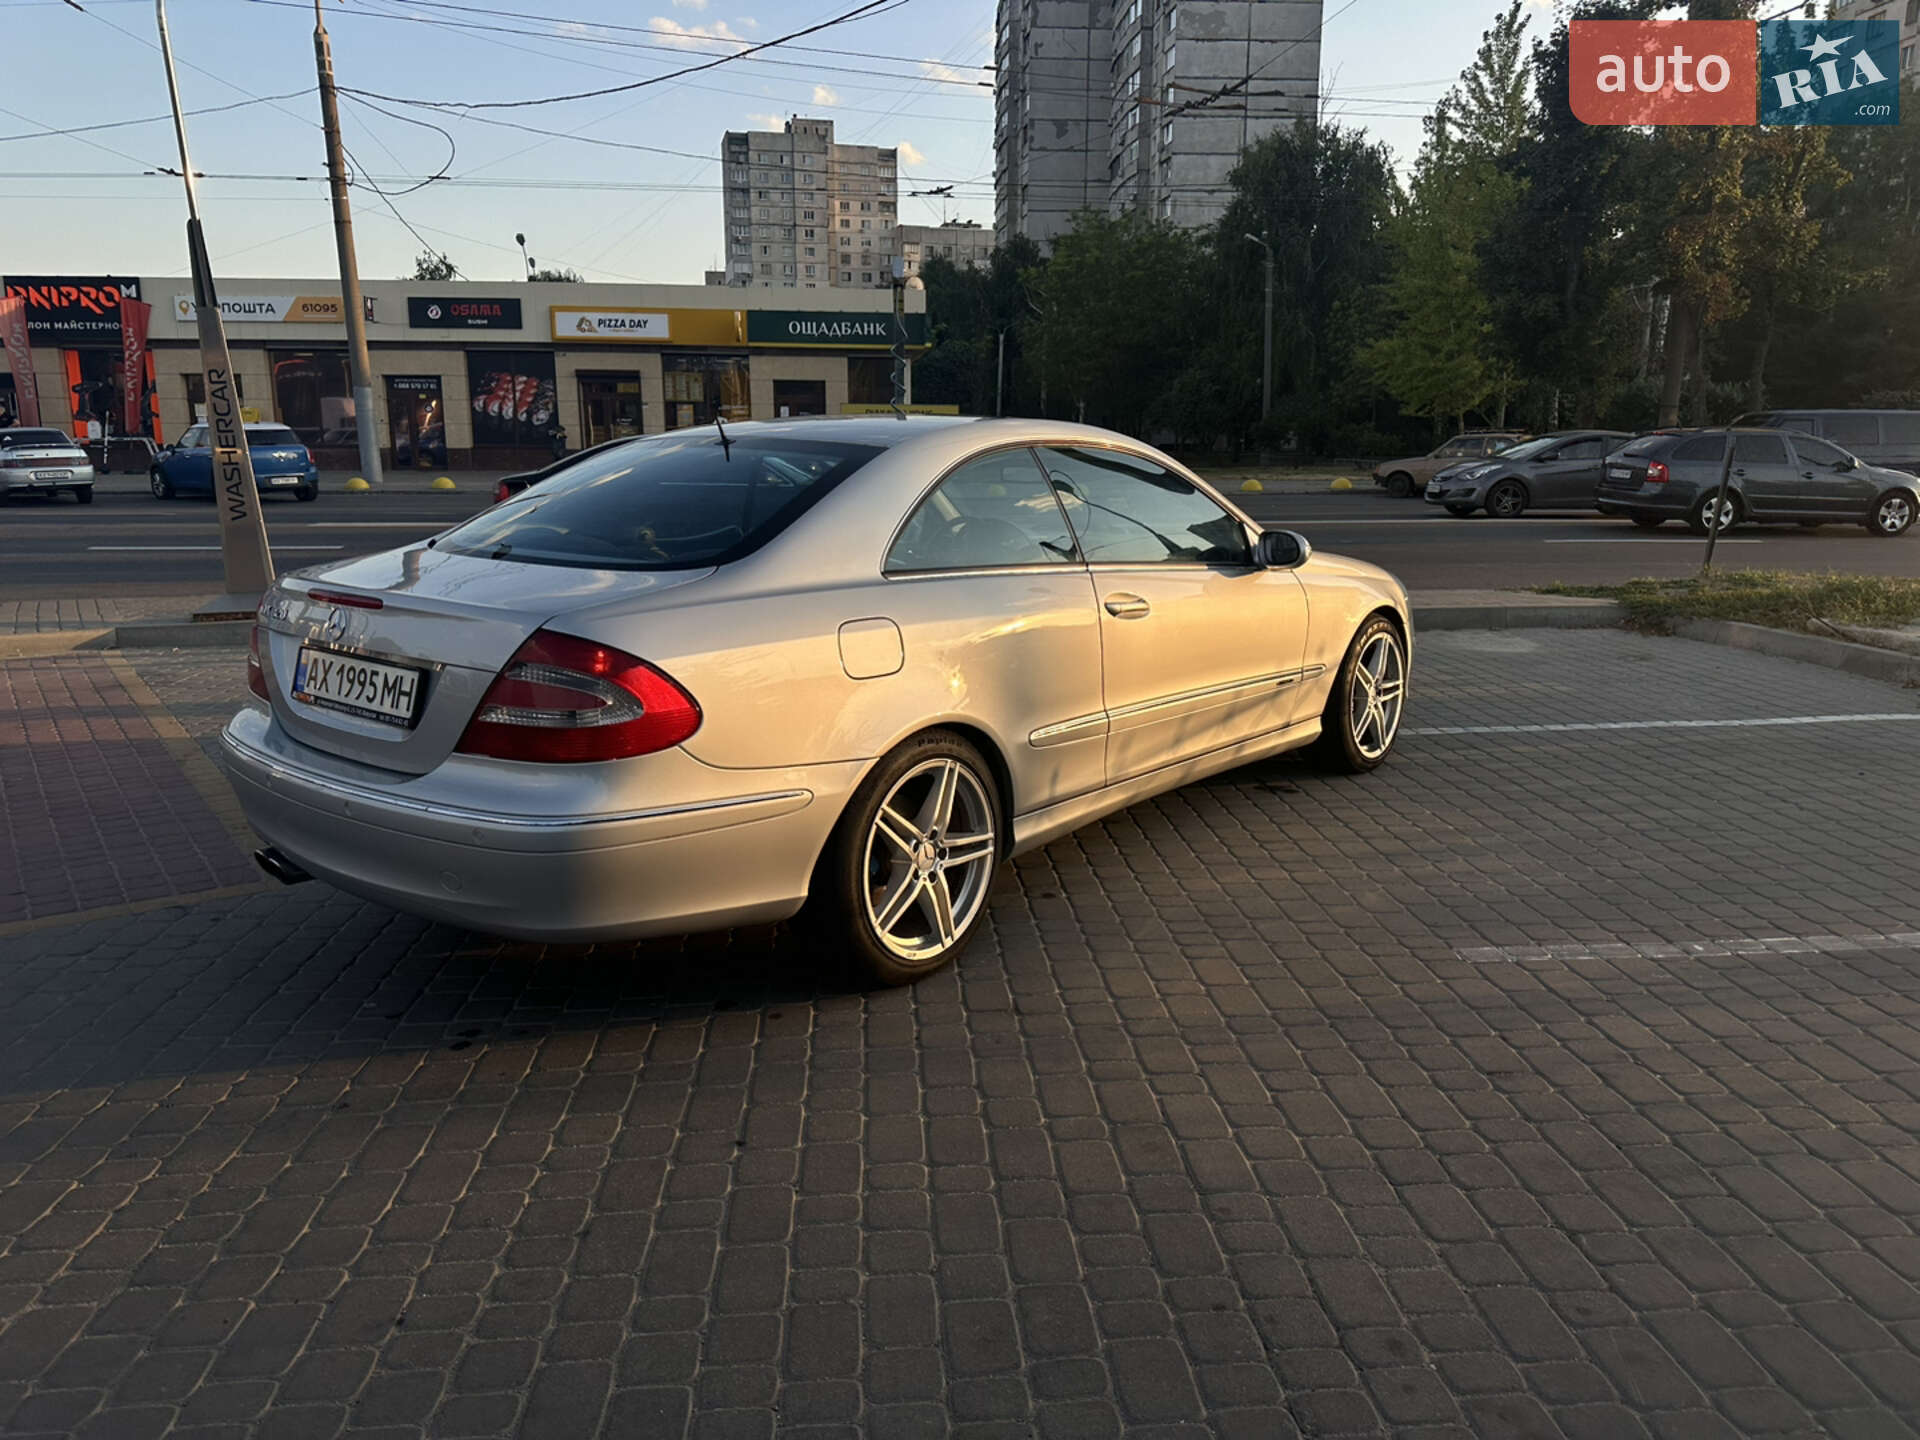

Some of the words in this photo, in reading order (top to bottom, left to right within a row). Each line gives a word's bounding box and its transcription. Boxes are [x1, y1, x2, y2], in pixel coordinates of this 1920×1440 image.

[191, 302, 276, 314] ПОШТА
[302, 303, 338, 313] 61095
[451, 304, 502, 316] OSAMA
[54, 318, 121, 330] МАЙСТЕРНО
[598, 318, 627, 328] PIZZA
[629, 319, 648, 328] DAY
[788, 320, 887, 337] ОЩАДБАНК
[208, 368, 247, 521] WASHERCAR
[306, 657, 335, 694] AX
[336, 663, 380, 705] 1995
